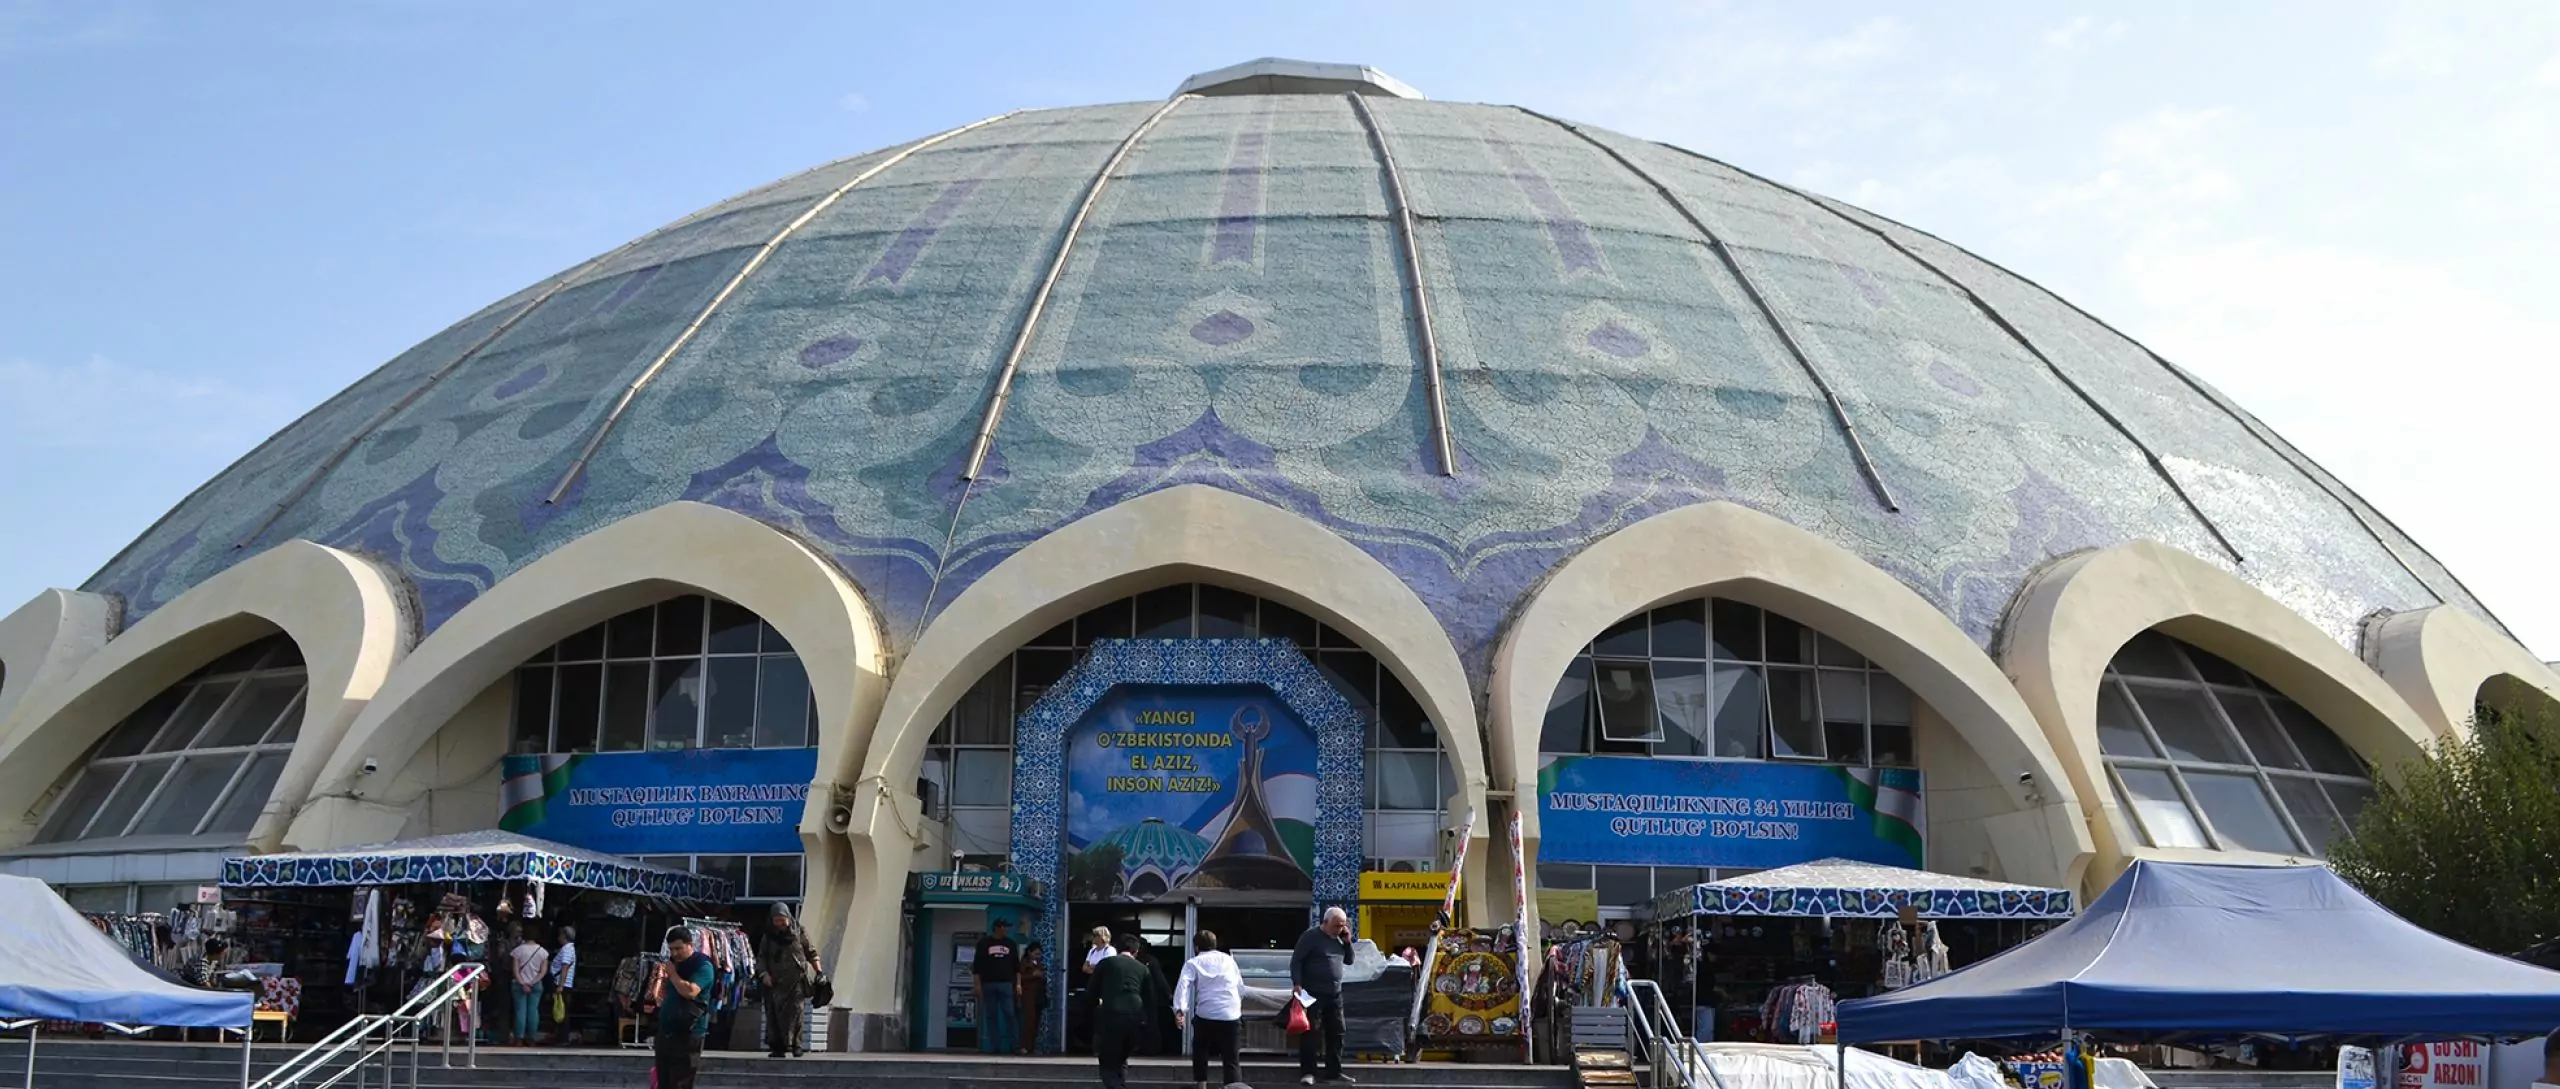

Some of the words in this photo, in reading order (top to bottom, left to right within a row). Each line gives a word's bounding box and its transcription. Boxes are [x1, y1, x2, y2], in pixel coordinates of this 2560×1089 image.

[1135, 710, 1195, 725] «YANGI
[1130, 755, 1148, 770] EL
[1153, 755, 1198, 772] AZIZ,
[1107, 777, 1162, 792] INSON
[1167, 776, 1221, 793] AZIZ!»
[569, 786, 696, 806] MUSTAQILLIK
[1550, 792, 1750, 815] MUSTAQILLIKNING
[1754, 800, 1778, 817] 34
[1782, 800, 1855, 820] YILLIGI
[940, 875, 992, 888] UZNKASS
[1384, 881, 1446, 889] KAPITALBANK
